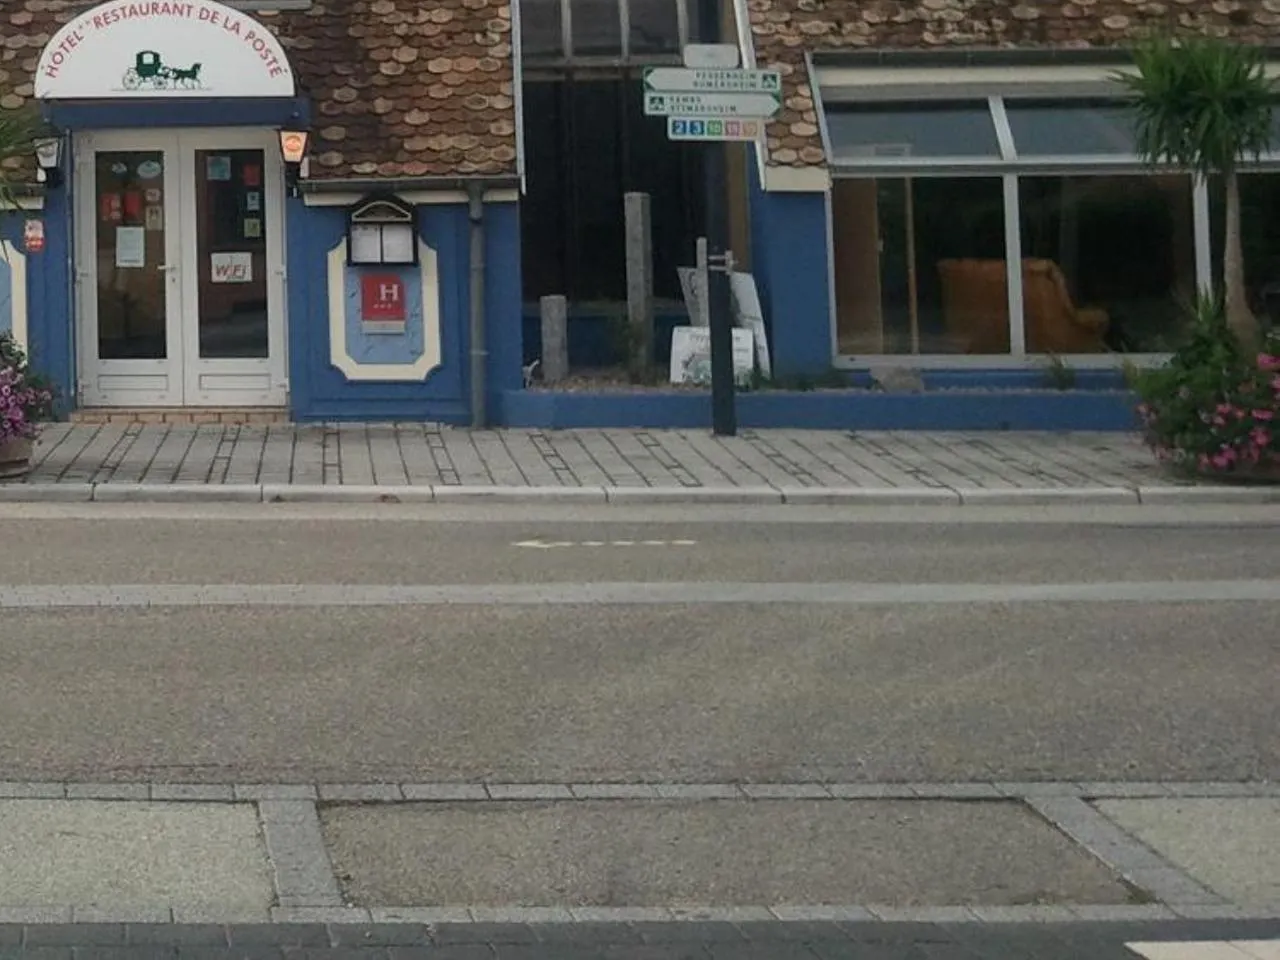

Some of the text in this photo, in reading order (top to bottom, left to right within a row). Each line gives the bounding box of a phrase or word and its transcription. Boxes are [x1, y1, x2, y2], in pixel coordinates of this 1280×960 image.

[93, 1, 192, 30] RESTAURANT
[199, 7, 219, 24] DE
[223, 16, 241, 35] LA
[244, 30, 282, 79] POSTE
[379, 283, 399, 301] H
